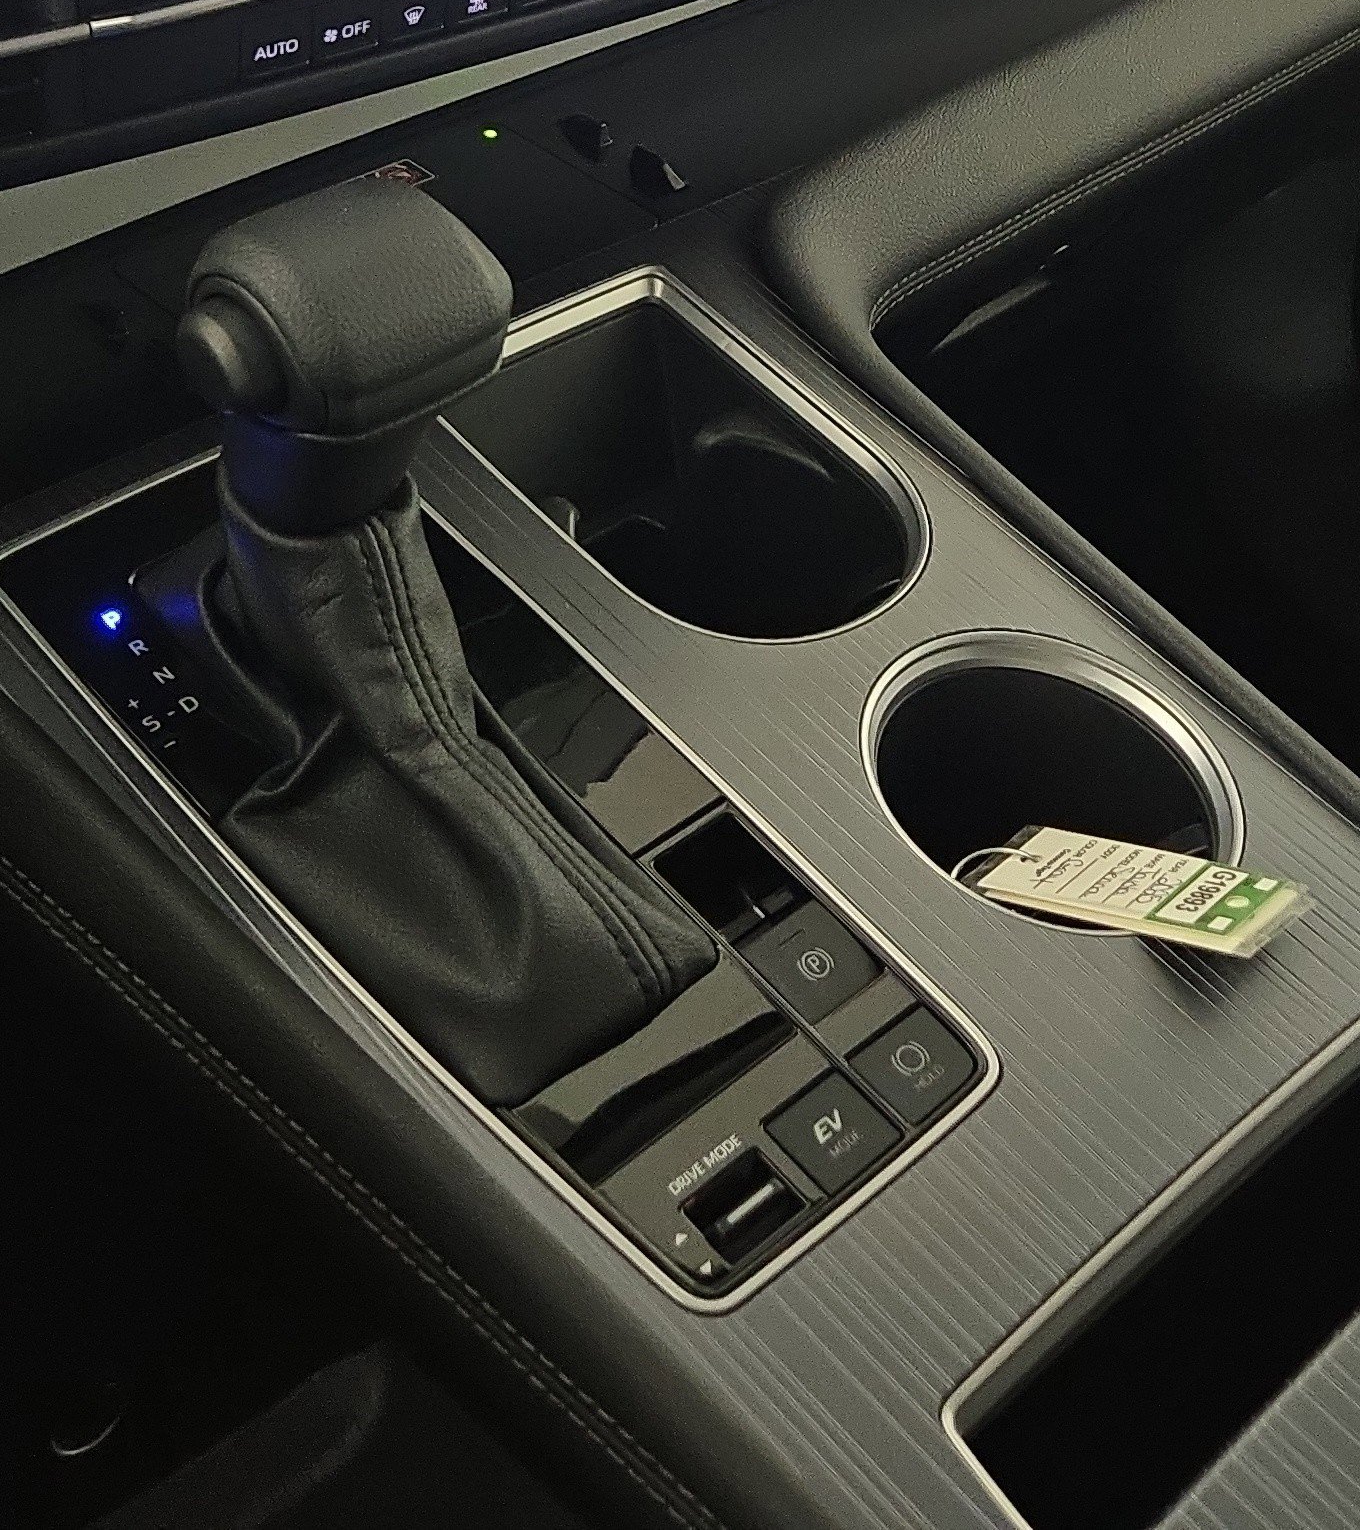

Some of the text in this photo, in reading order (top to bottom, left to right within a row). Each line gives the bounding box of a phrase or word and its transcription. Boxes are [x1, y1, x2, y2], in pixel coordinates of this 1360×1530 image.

[342, 20, 371, 39] OFF
[254, 38, 298, 61] AUTO
[128, 639, 149, 657] R
[152, 666, 175, 685] N
[178, 696, 199, 714] D
[142, 715, 161, 733] S
[1175, 871, 1238, 914] G19893
[814, 1108, 842, 1145] EV
[668, 1134, 743, 1197] DRIVE MODE
